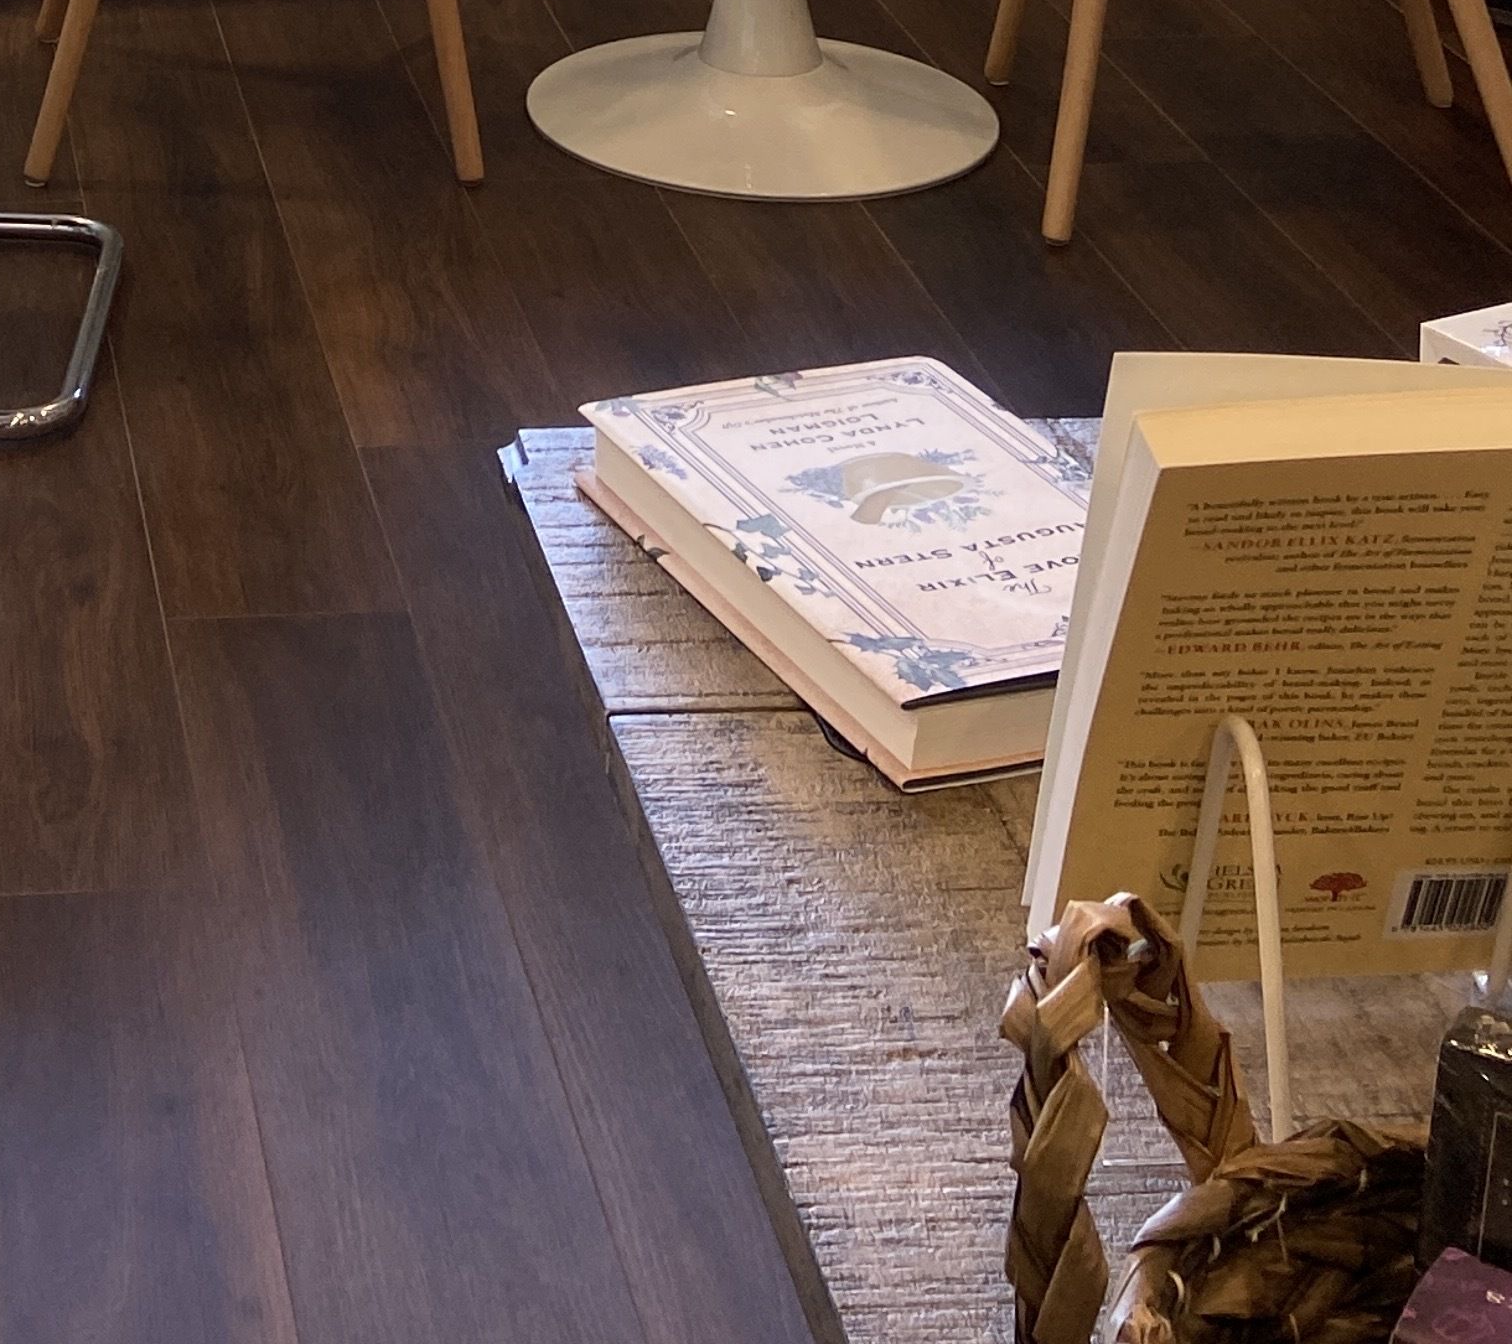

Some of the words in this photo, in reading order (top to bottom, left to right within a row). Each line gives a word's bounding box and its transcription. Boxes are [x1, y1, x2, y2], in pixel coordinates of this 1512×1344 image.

[769, 413, 878, 436] LOIGMAN
[842, 418, 925, 438] LYNDA
[750, 434, 834, 452] COHEN
[852, 547, 952, 571] STERN
[981, 550, 1005, 572] of
[1022, 554, 1079, 574] OVE
[916, 568, 1016, 594] ELIXIR
[1001, 576, 1052, 597] The
